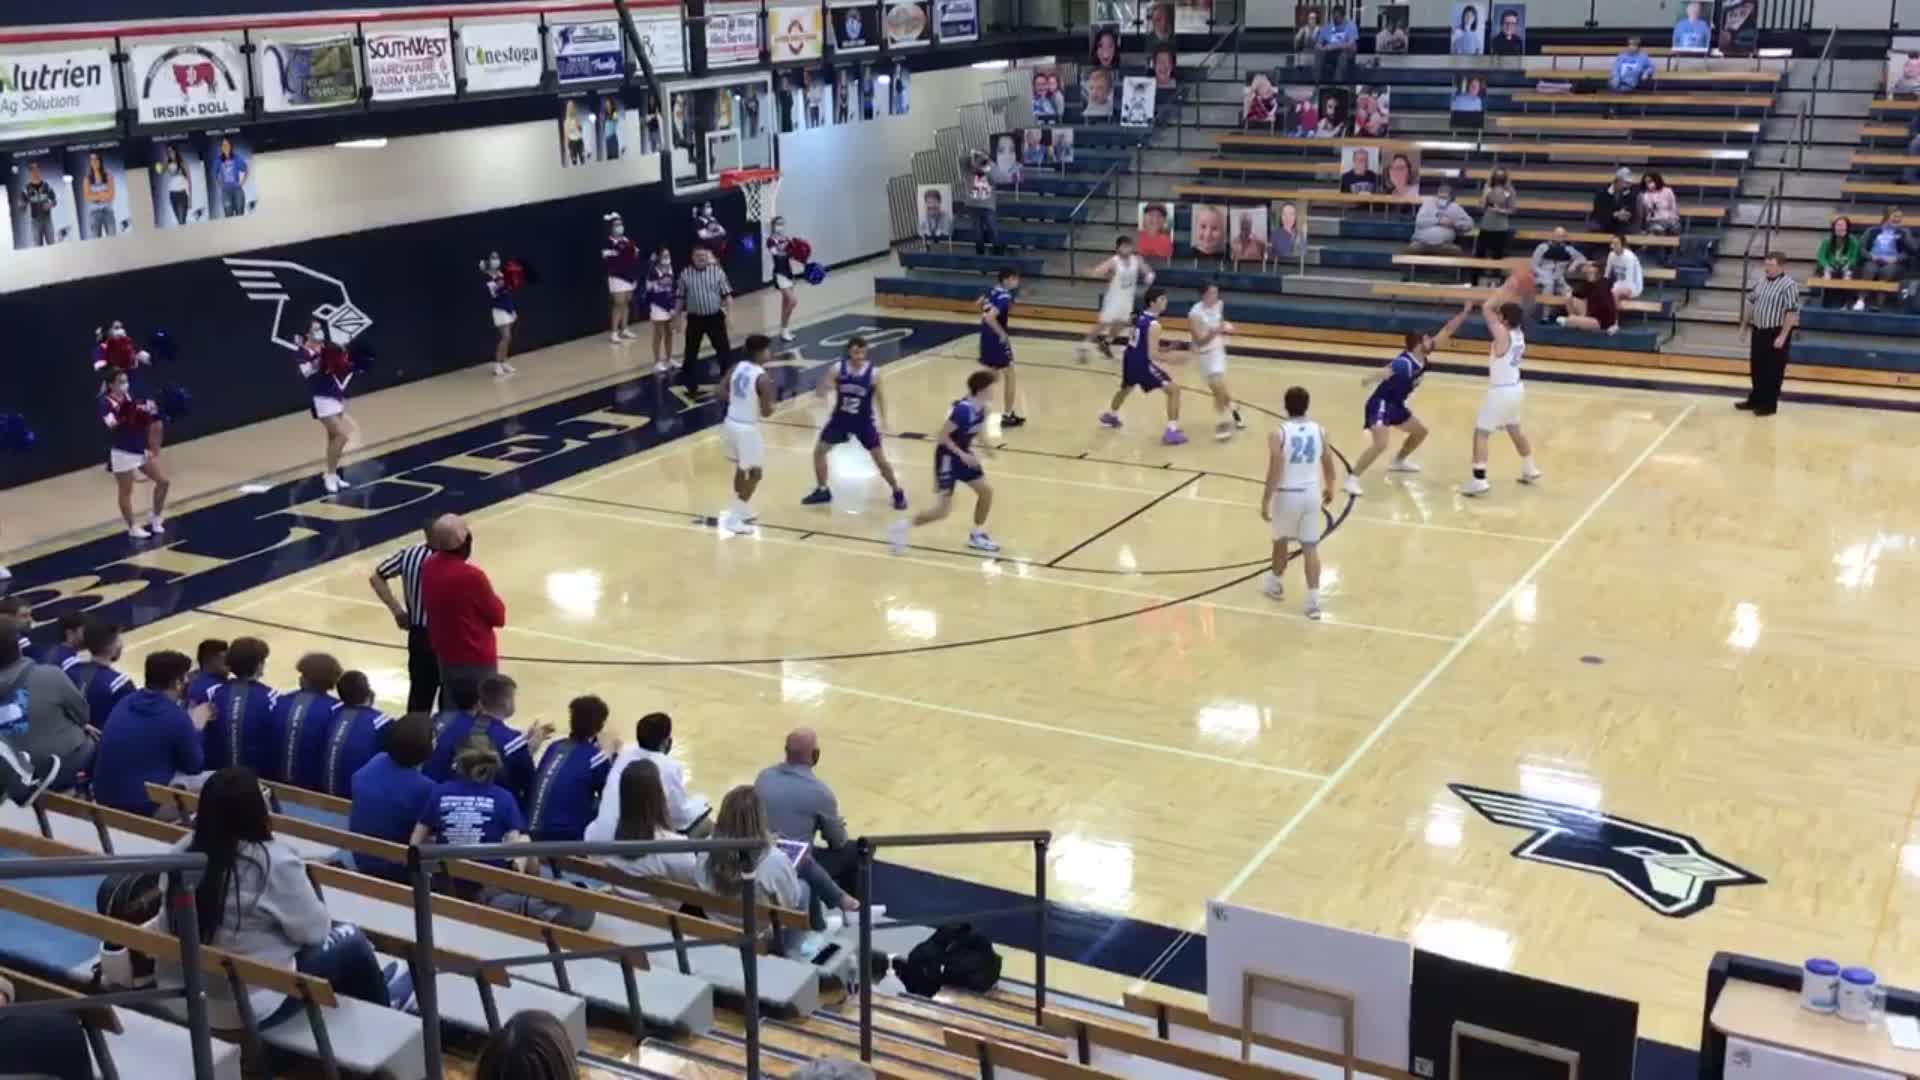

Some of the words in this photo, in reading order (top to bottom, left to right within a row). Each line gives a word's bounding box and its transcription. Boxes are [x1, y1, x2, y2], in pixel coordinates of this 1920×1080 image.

[367, 36, 448, 59] SOUTHWEST
[465, 44, 538, 66] Conestoga
[0, 59, 101, 91] Nutrien
[21, 94, 81, 112] Solutions
[153, 104, 189, 119] IRSIK
[198, 101, 229, 114] DOLL
[1289, 435, 1315, 464] 24
